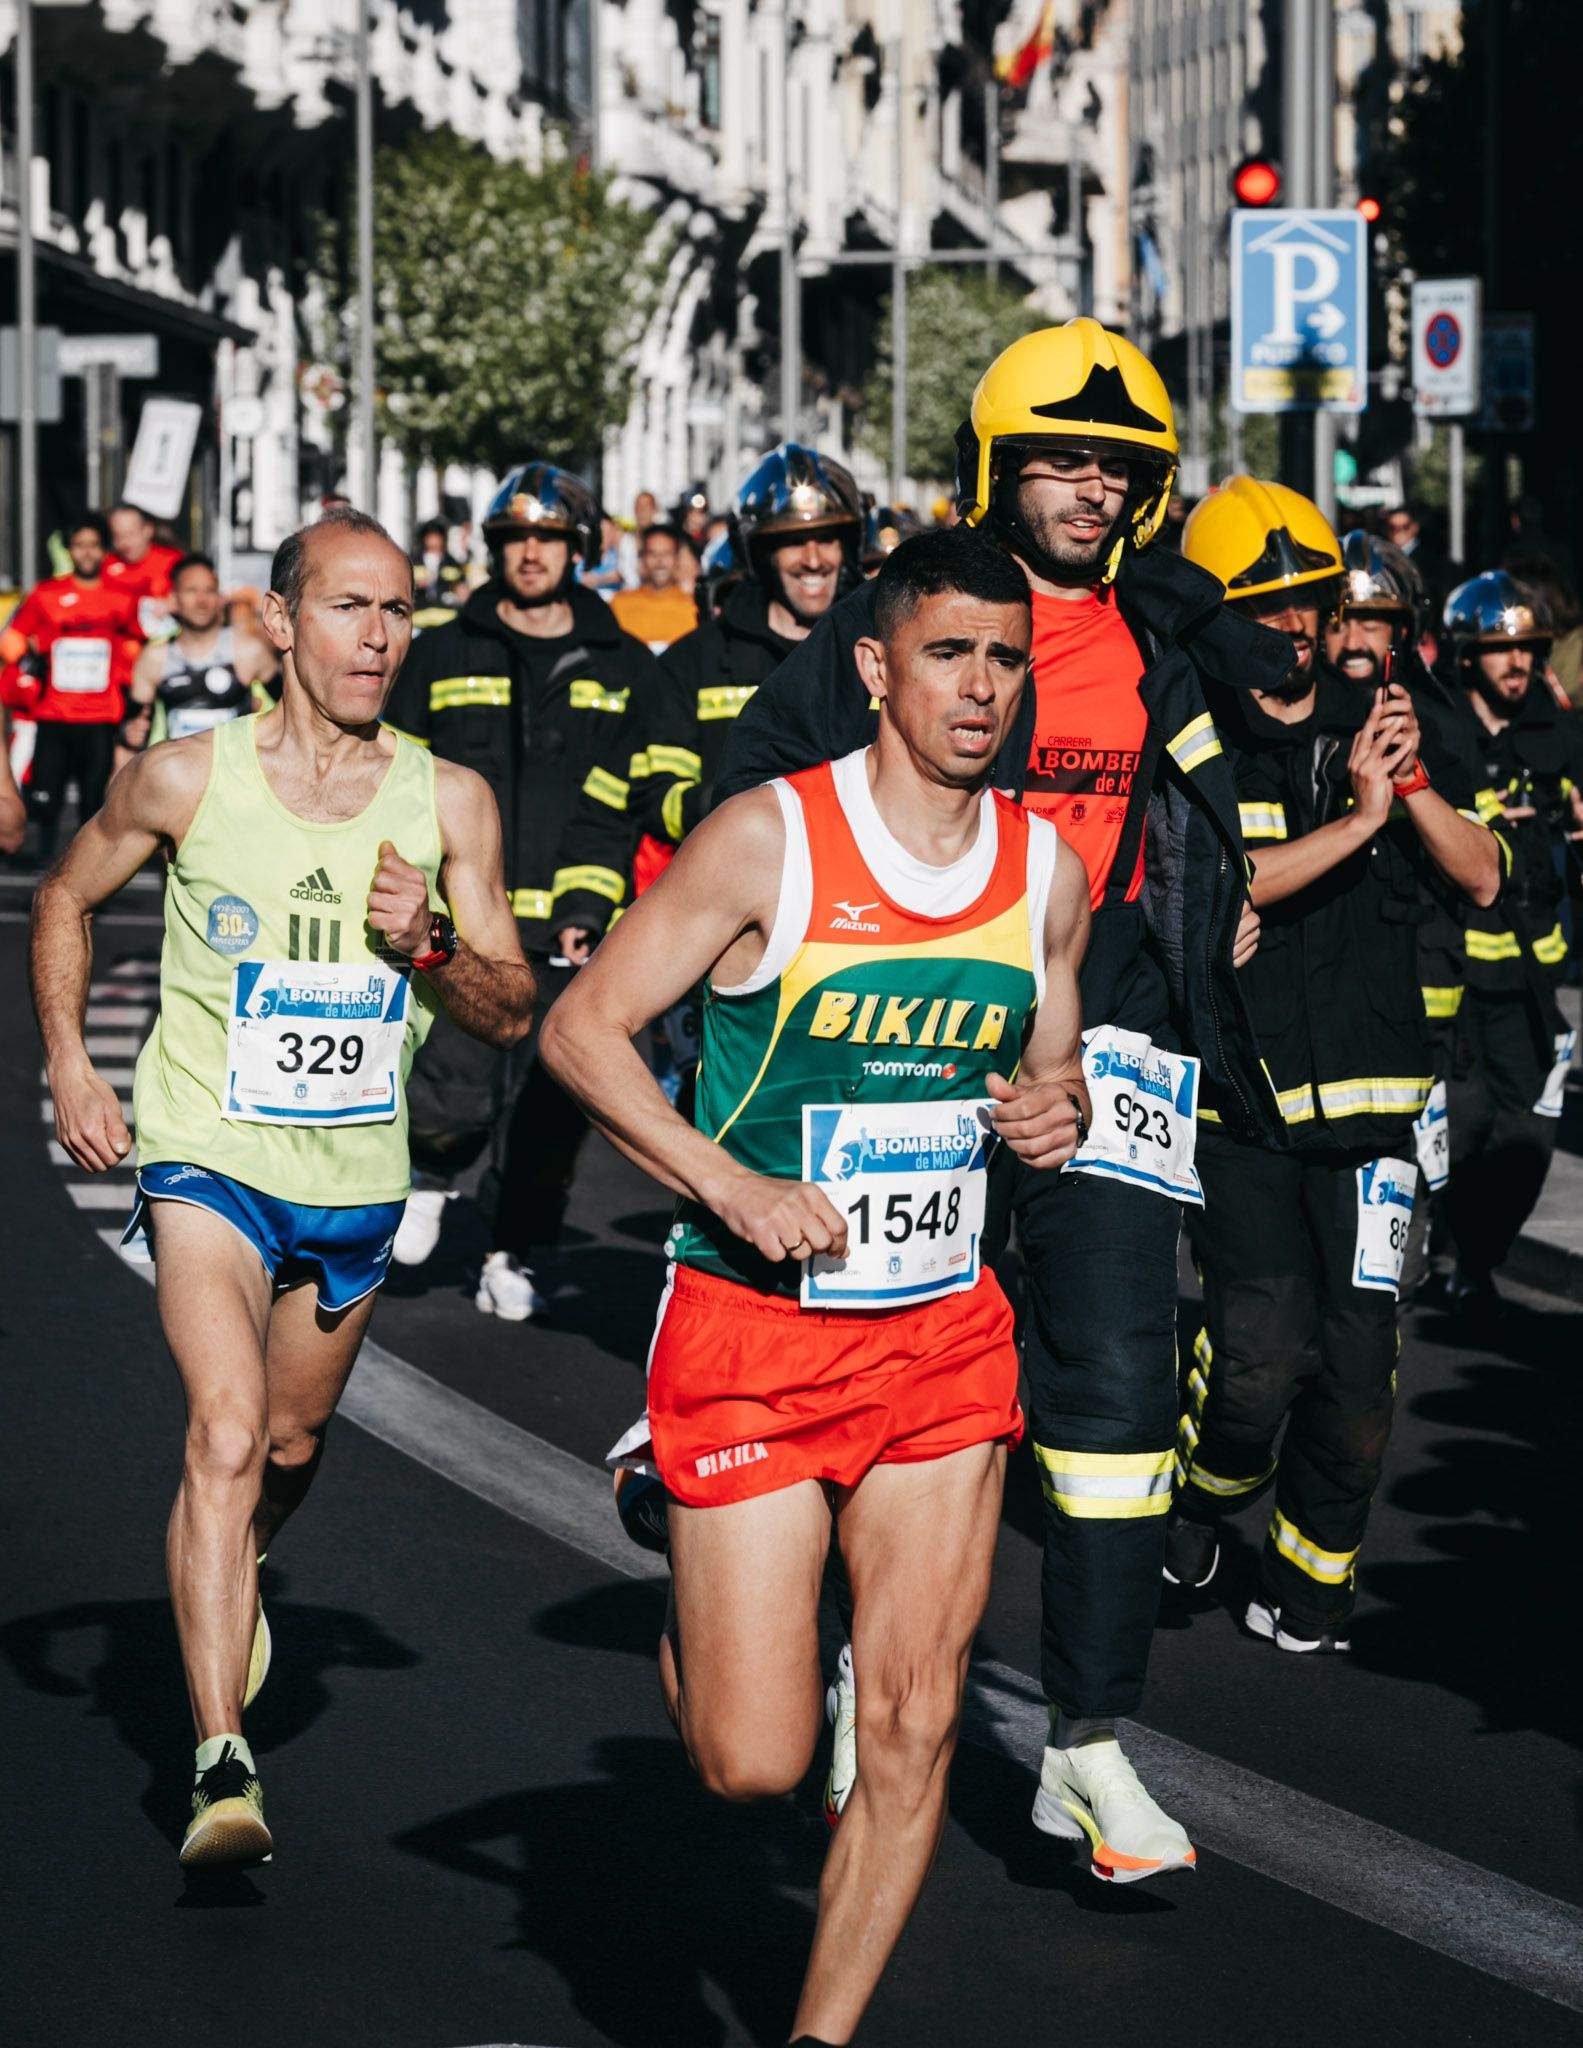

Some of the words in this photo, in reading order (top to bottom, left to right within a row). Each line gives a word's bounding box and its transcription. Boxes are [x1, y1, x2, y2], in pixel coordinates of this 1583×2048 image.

[1261, 241, 1340, 344] P
[1047, 736, 1092, 747] CARRERA
[1095, 772, 1115, 793] de
[289, 887, 341, 904] adidas
[289, 988, 382, 1005] BOMBEROS
[325, 1004, 339, 1018] de
[341, 1004, 380, 1018] MADRID
[808, 990, 1009, 1052] BIKILA
[276, 1032, 364, 1075] 329
[1114, 1093, 1172, 1149] 923
[875, 1134, 974, 1155] BOMBEROS
[915, 1153, 929, 1170] de
[848, 1186, 961, 1244] 1548
[695, 1442, 769, 1478] BIKILA
